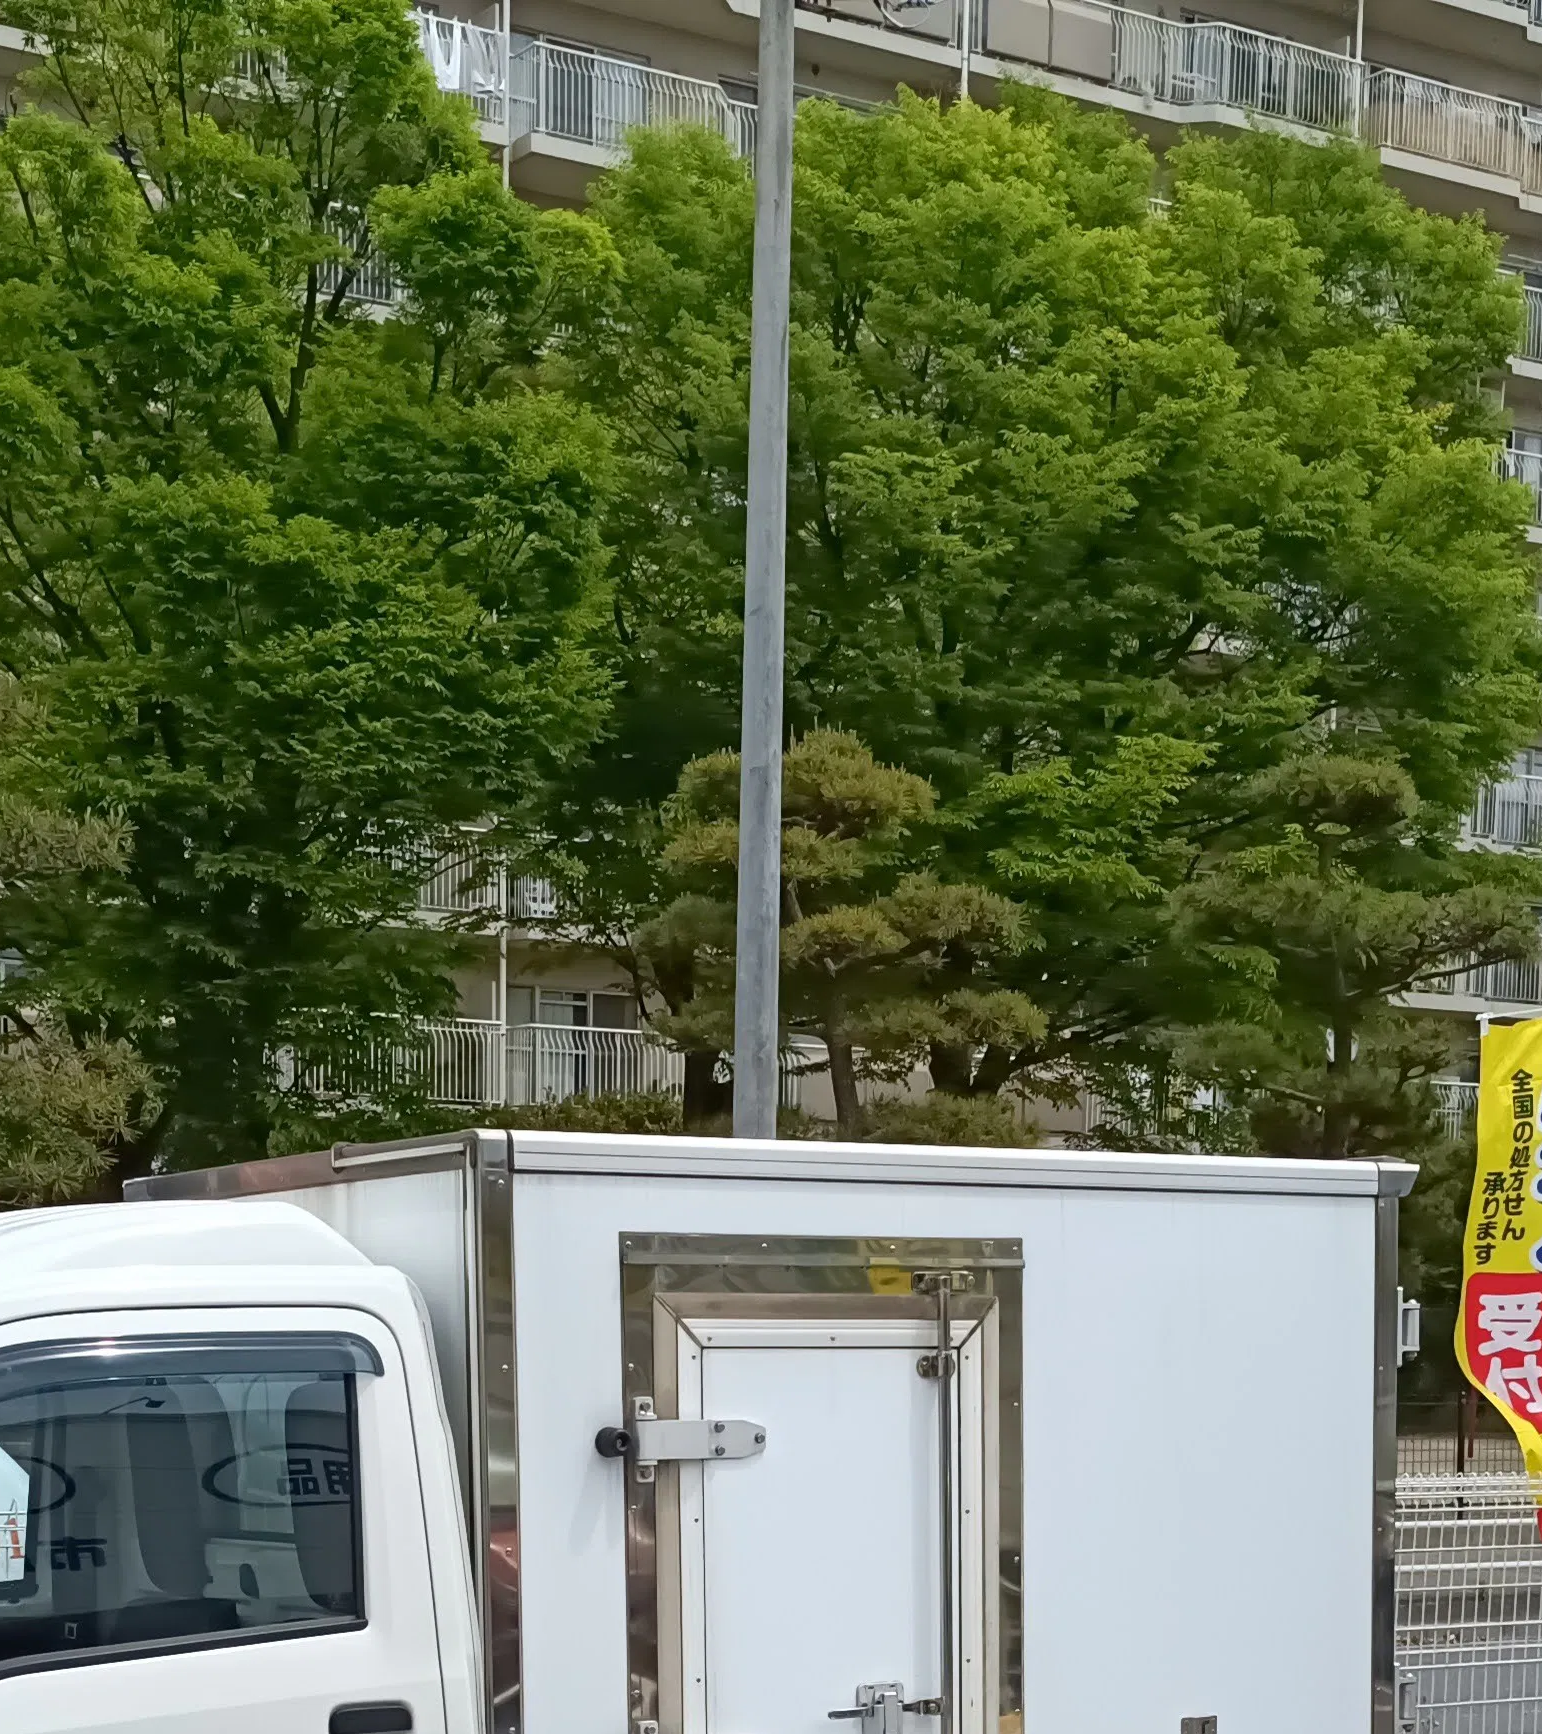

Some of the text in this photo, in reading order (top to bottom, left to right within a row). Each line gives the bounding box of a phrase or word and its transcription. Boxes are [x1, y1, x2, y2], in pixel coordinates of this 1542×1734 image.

[1473, 1171, 1508, 1265] 承ります
[1500, 1068, 1534, 1243] 全国の処方せん
